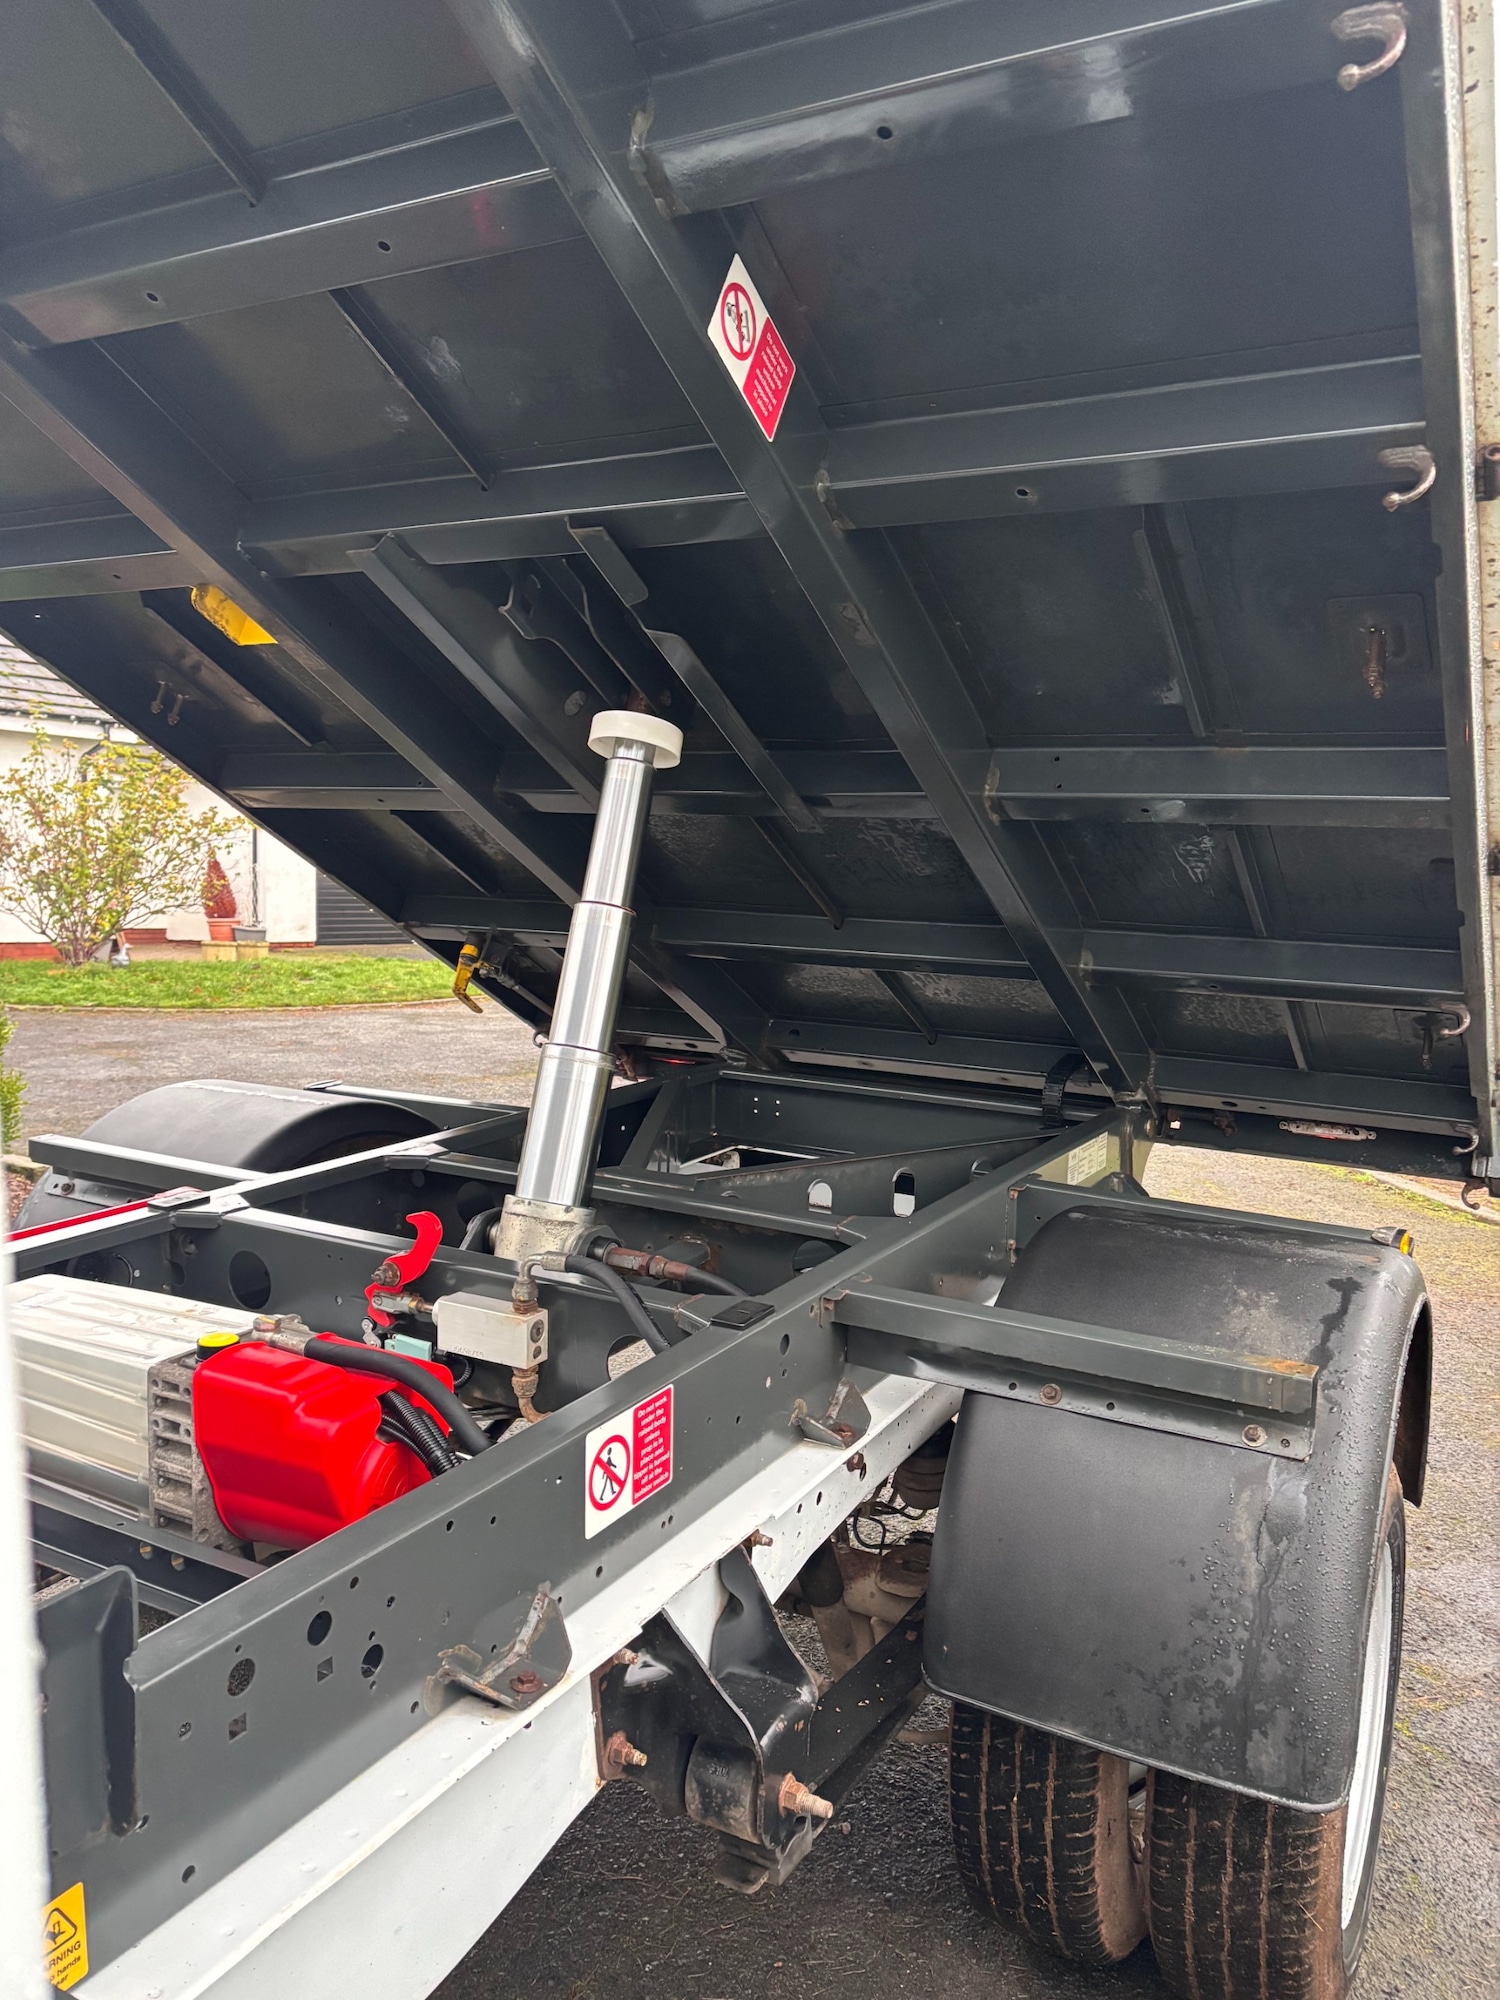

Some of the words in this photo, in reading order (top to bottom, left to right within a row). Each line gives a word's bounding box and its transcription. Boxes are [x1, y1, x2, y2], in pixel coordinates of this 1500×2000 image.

[766, 332, 773, 345] Do
[772, 344, 780, 357] not
[778, 355, 788, 374] work
[766, 346, 777, 365] under
[761, 351, 774, 373] raised
[773, 371, 782, 390] body
[763, 368, 775, 390] unless
[754, 378, 769, 405] support
[756, 368, 777, 406] mechanical
[757, 398, 768, 417] place
[638, 1410, 646, 1418] Do
[645, 1403, 655, 1413] not
[655, 1395, 667, 1407] work
[641, 1413, 656, 1426] under
[656, 1408, 664, 1417] the
[638, 1422, 654, 1438] raised
[654, 1416, 666, 1428] body
[644, 1430, 660, 1444] unless
[640, 1453, 654, 1468] place
[654, 1445, 664, 1457] and
[641, 1445, 653, 1457] prop
[653, 1440, 658, 1448] is
[658, 1437, 664, 1445] in
[633, 1466, 649, 1480] tipper
[648, 1462, 654, 1470] is
[653, 1451, 670, 1467] turned
[641, 1474, 649, 1485] off
[648, 1471, 654, 1480] at
[654, 1466, 663, 1476] the
[634, 1482, 653, 1499] isolator
[653, 1471, 669, 1486] switch
[47, 1940, 81, 1970] RNING
[56, 1955, 81, 1977] hands
